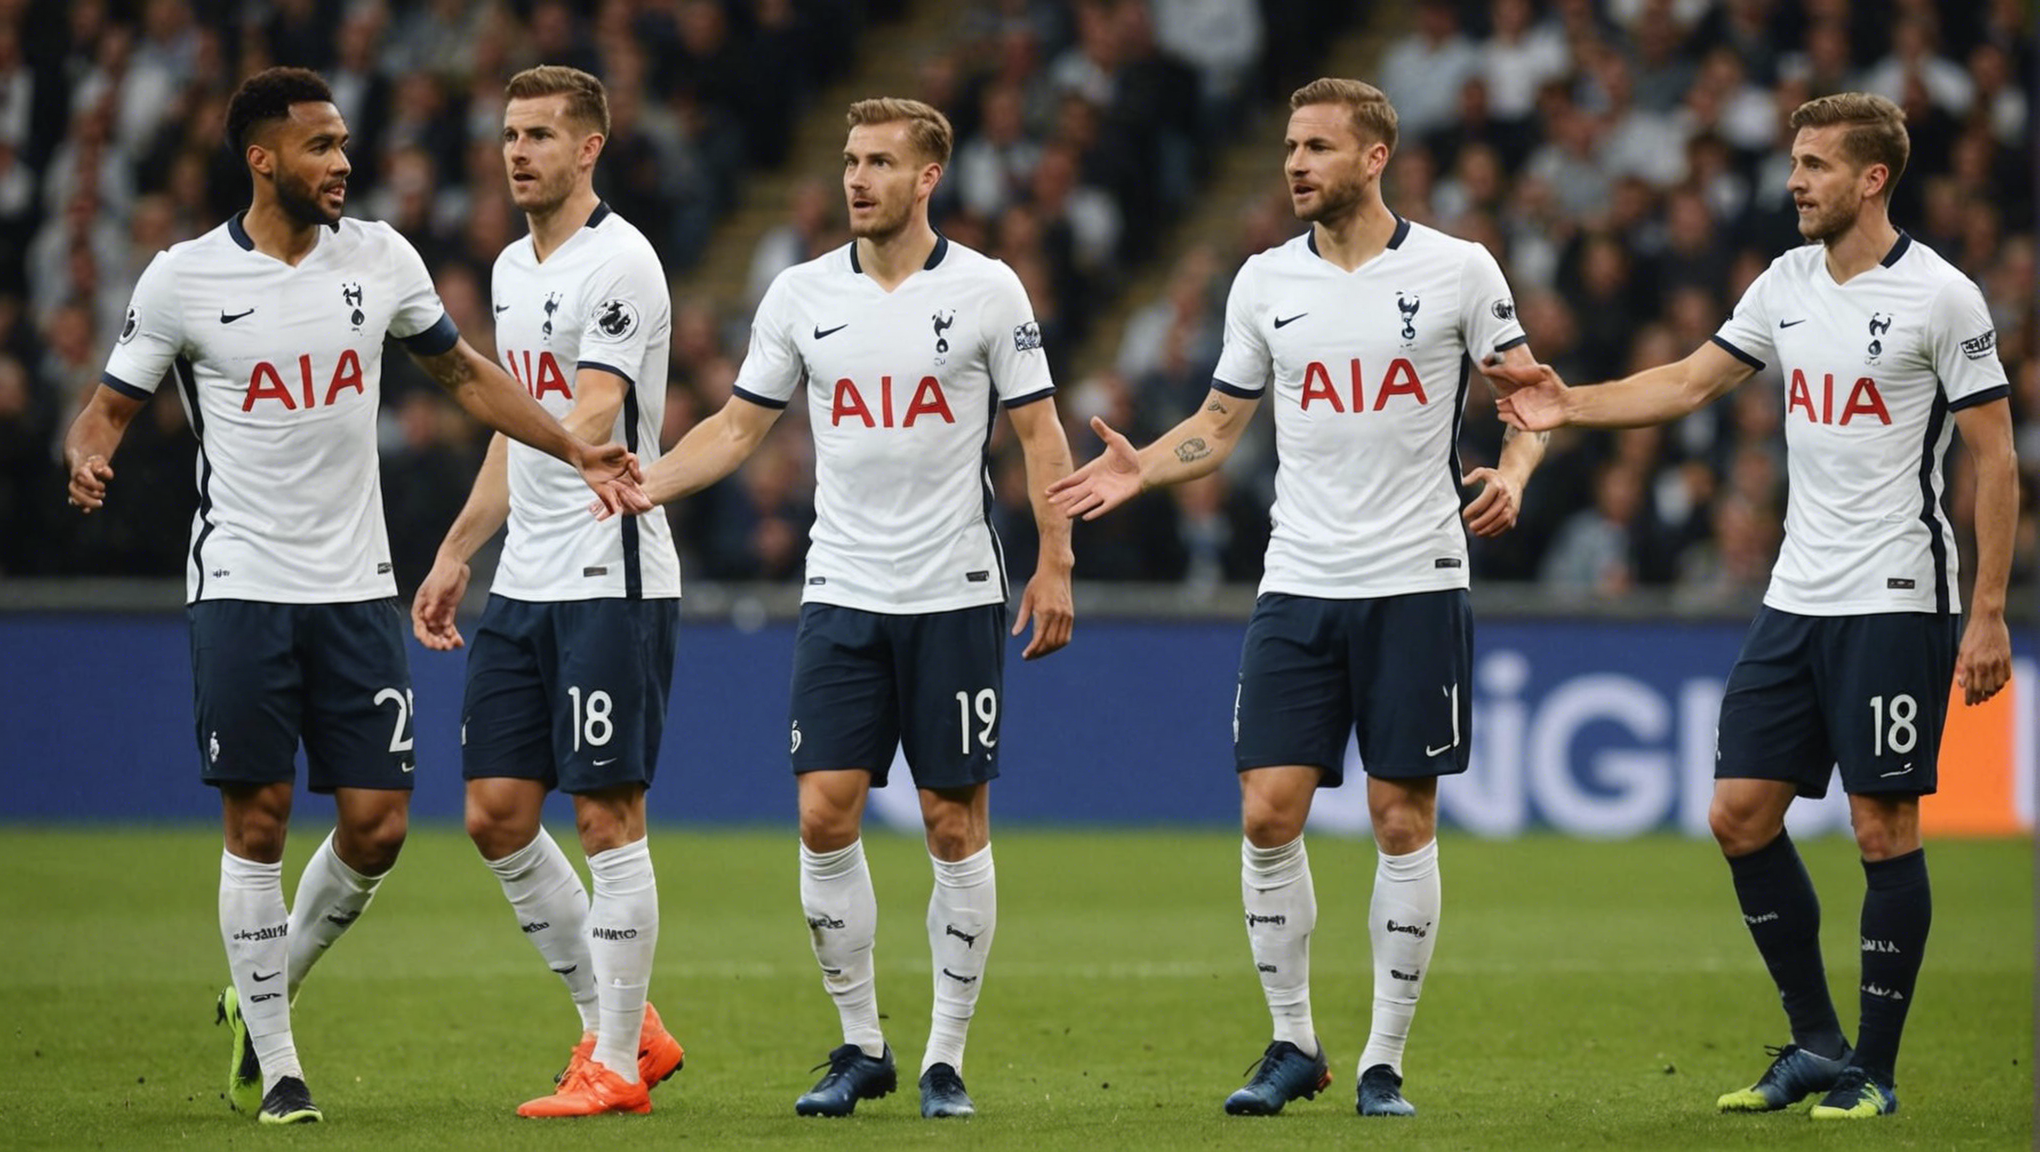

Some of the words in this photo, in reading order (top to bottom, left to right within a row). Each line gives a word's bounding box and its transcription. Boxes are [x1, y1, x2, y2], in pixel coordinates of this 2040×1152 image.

[243, 350, 363, 411] AIA
[831, 376, 954, 428] AIA
[1301, 358, 1427, 412] AIA
[1789, 368, 1891, 425] AIA
[373, 688, 414, 752] 2
[568, 686, 613, 752] 18
[1869, 694, 1917, 756] 18
